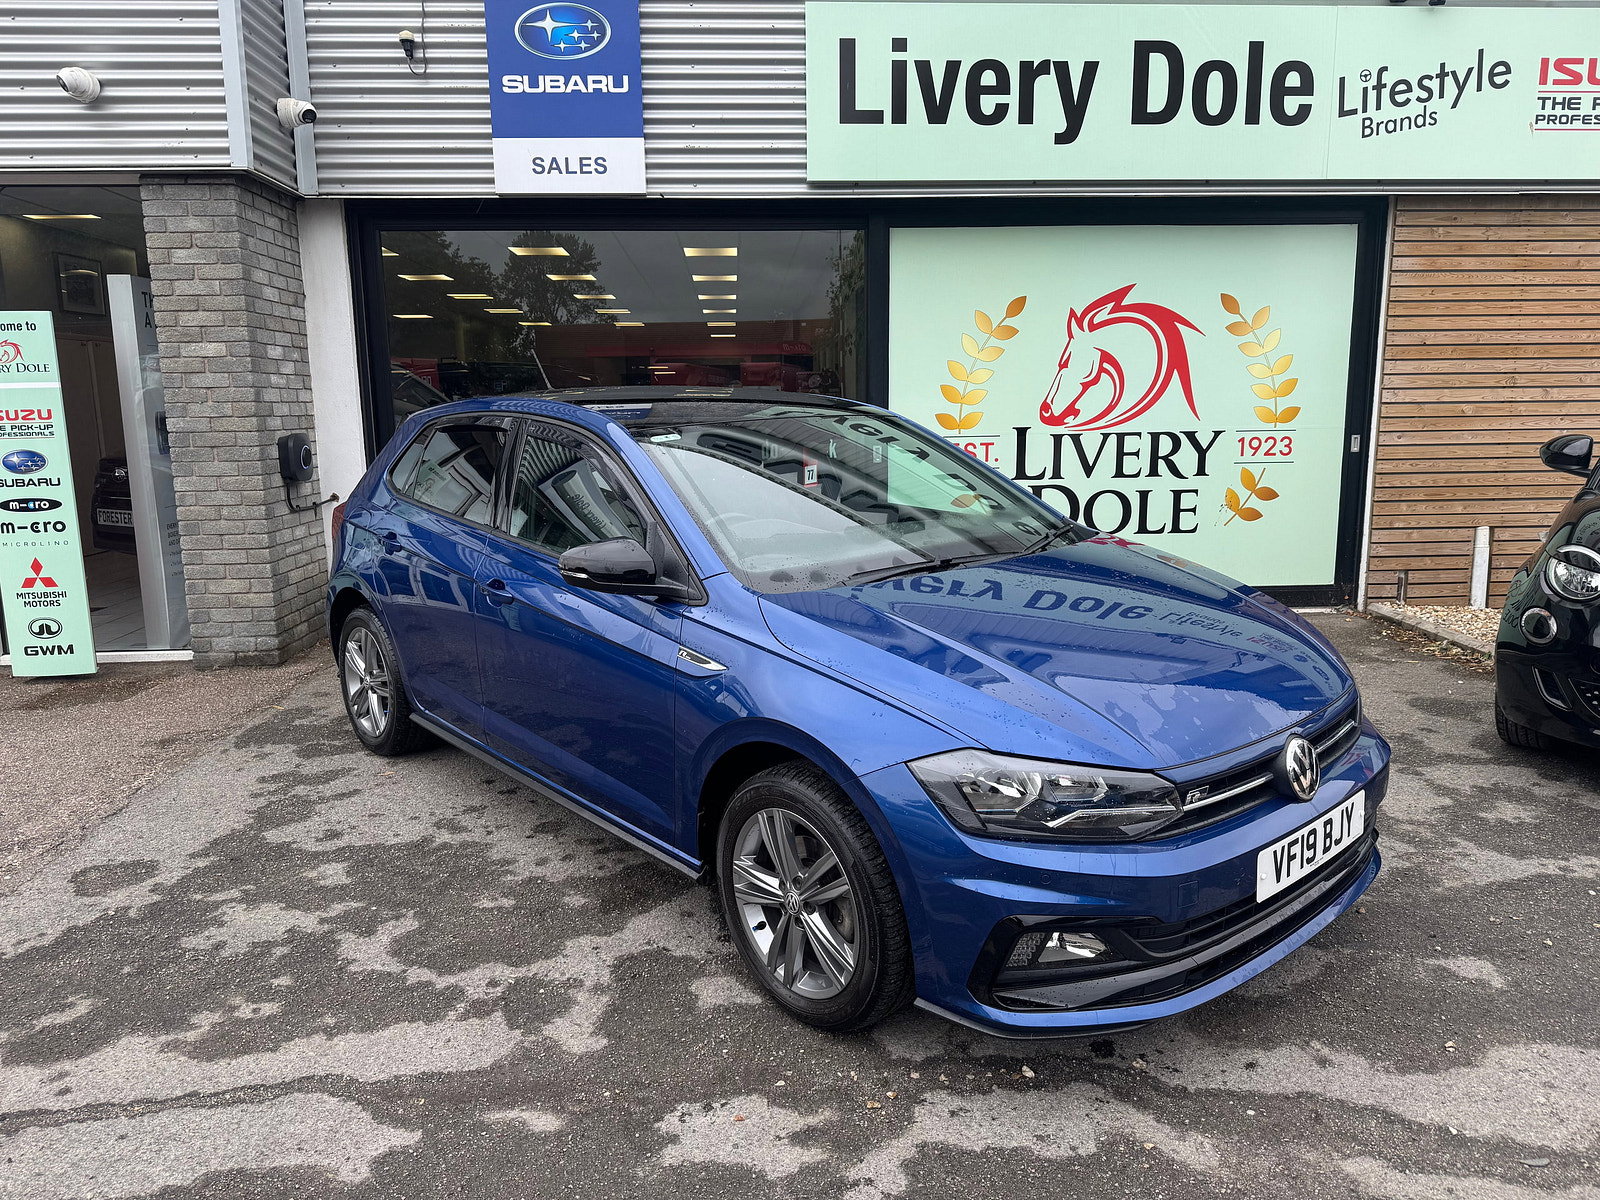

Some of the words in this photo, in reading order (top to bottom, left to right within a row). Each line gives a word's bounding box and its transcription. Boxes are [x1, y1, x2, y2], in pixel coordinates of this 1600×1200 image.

[502, 75, 629, 93] SUBARU
[839, 38, 1099, 145] Livery
[1130, 40, 1314, 126] Dole
[1338, 48, 1512, 118] Lifestyle
[1537, 97, 1581, 110] THE
[1361, 105, 1438, 139] Brands
[532, 156, 608, 175] SALES
[25, 321, 37, 331] to
[16, 362, 50, 373] DOLE
[1010, 427, 1226, 481] LIVERY
[1237, 435, 1293, 458] 1923
[99, 510, 133, 525] FORESTER
[16, 591, 67, 600] MITSUBISHI
[24, 599, 61, 608] MOTORS
[24, 644, 75, 657] GWM
[1273, 827, 1317, 884] VF19
[1322, 802, 1355, 855] BJY
